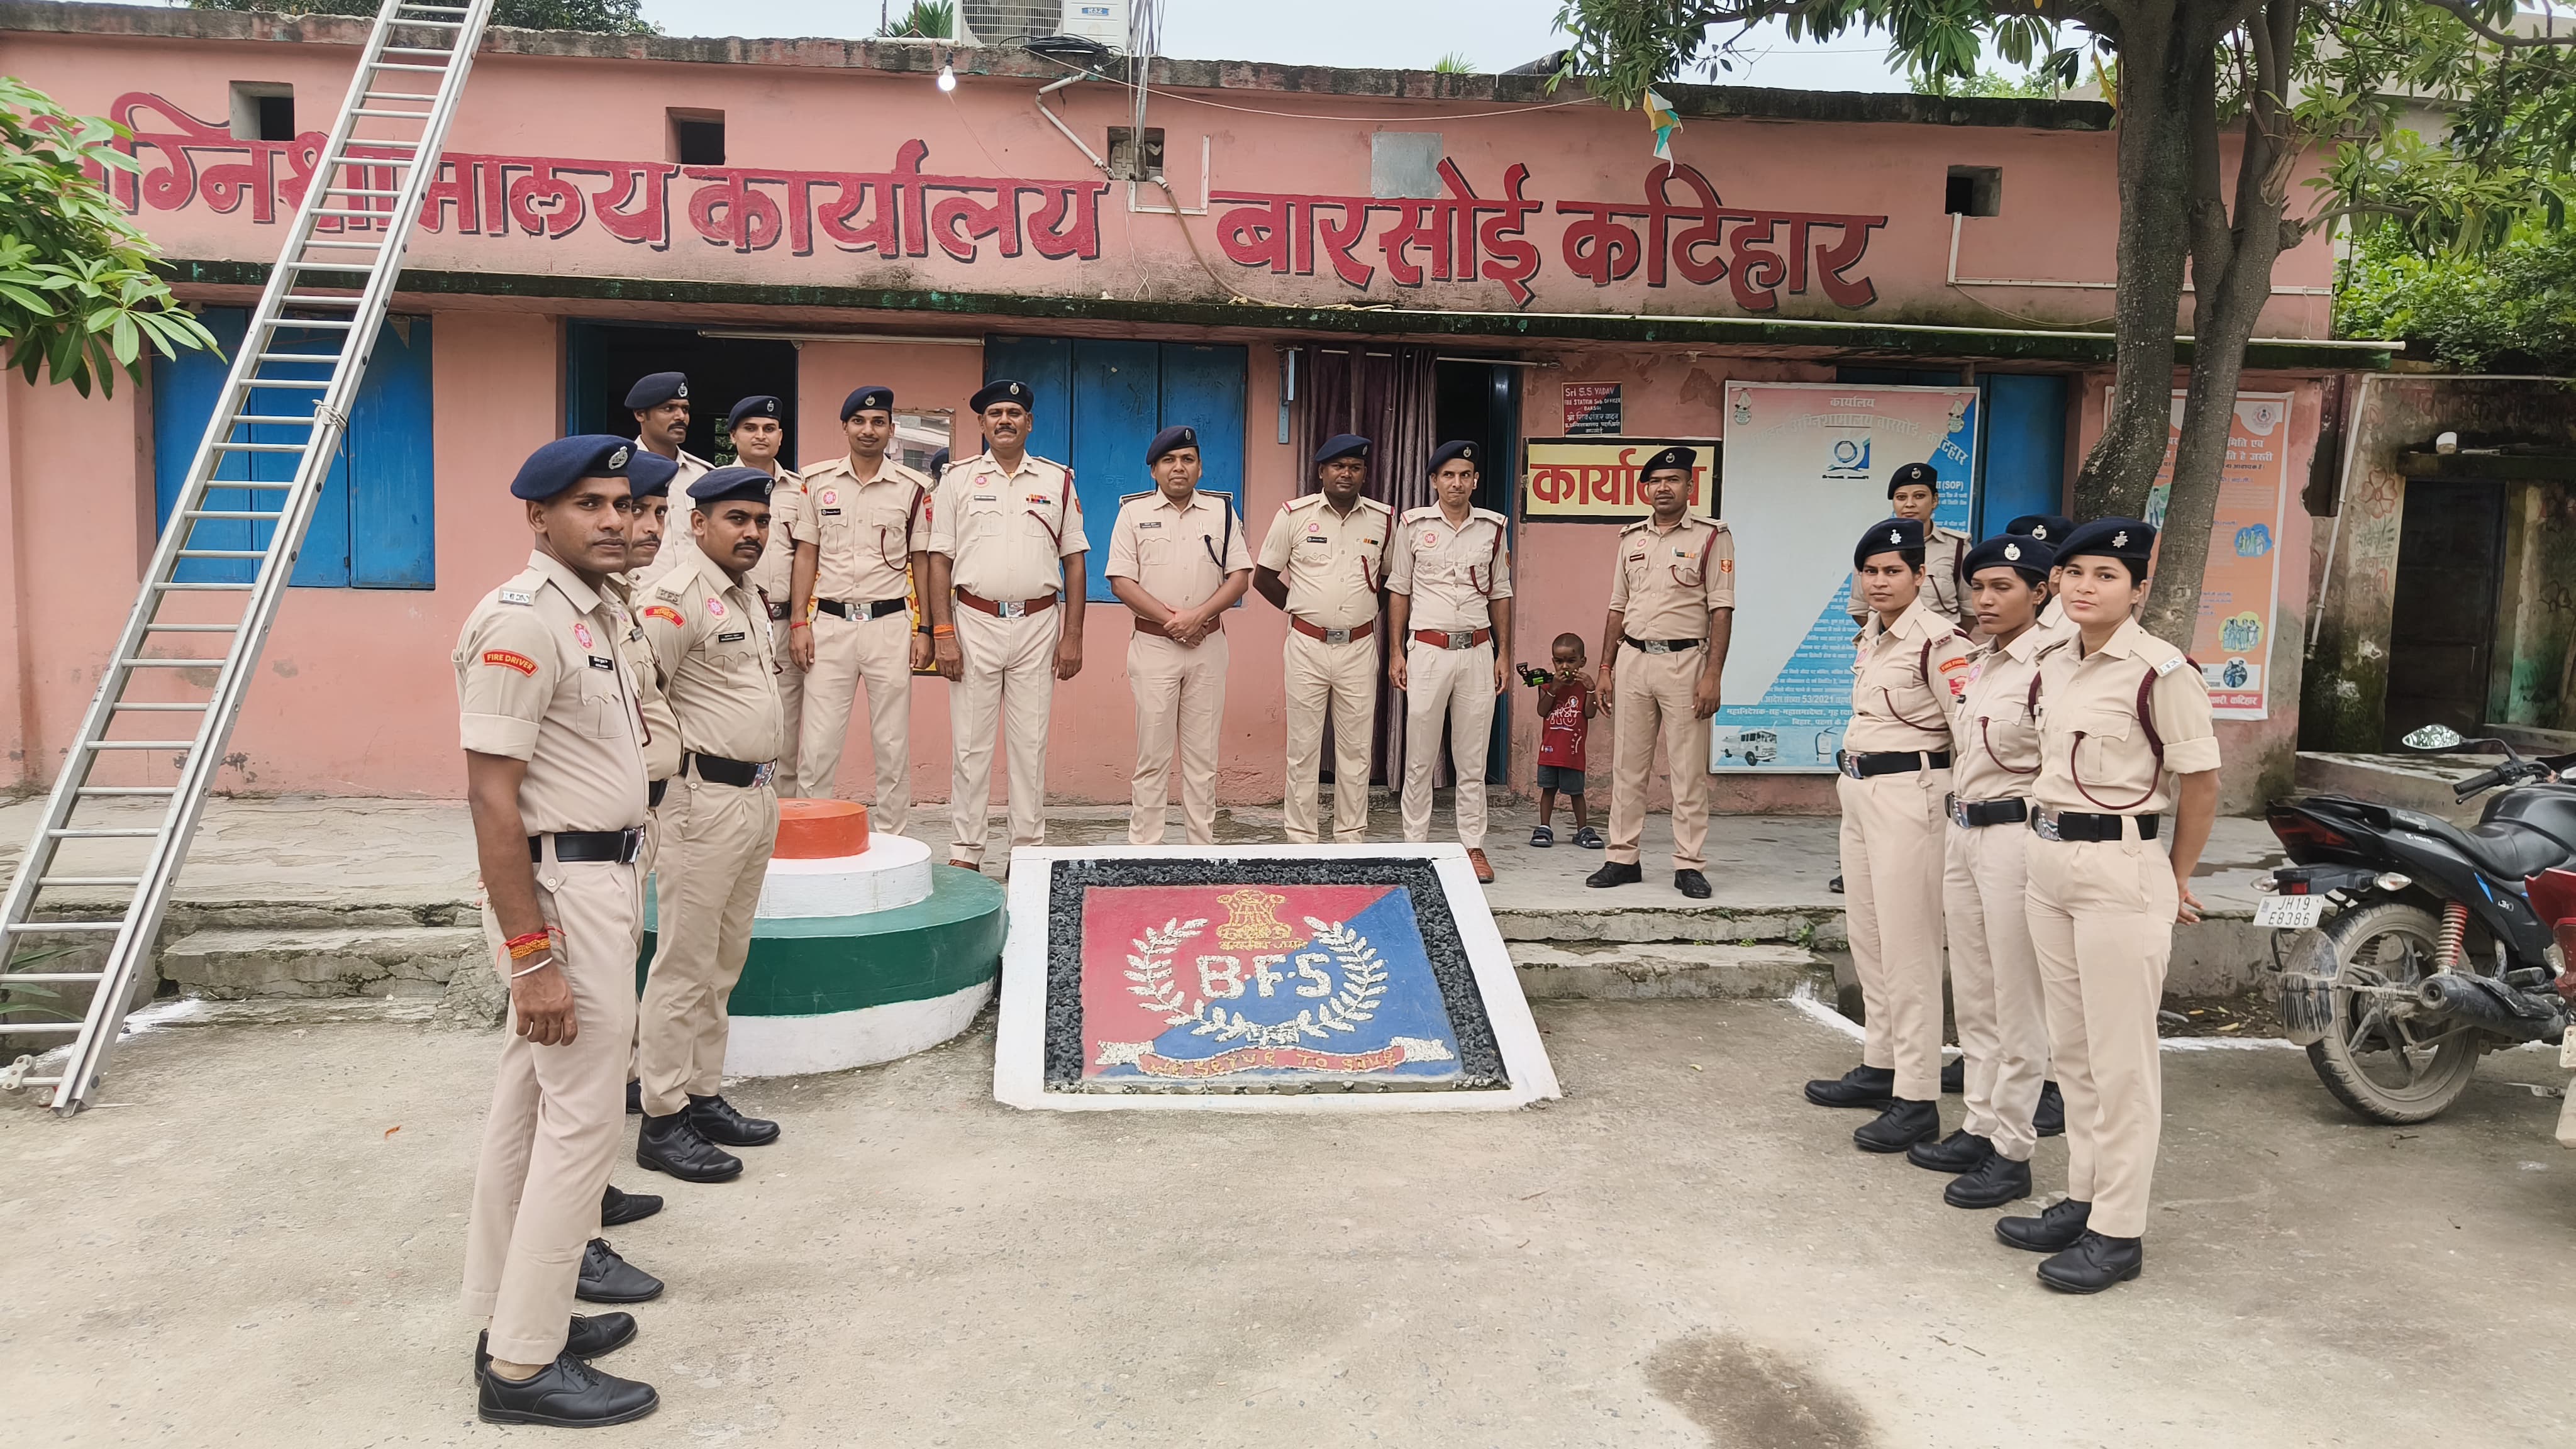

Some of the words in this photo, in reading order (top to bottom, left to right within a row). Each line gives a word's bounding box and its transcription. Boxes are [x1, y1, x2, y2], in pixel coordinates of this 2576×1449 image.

[683, 138, 1111, 262] कार्यालय
[1209, 157, 1543, 308] बारसोई
[1557, 162, 1888, 311] कटिहार
[1594, 387, 1614, 396] YADAV
[1829, 396, 1875, 408] कार्यालय
[1942, 480, 1964, 491] (SOP)
[487, 653, 504, 662] FIRE
[504, 655, 534, 671] DRIVER
[1802, 695, 1834, 704] 53/2021
[2278, 897, 2311, 910] JH19
[2268, 912, 2310, 926] E8386
[1296, 1052, 1328, 1068] TO
